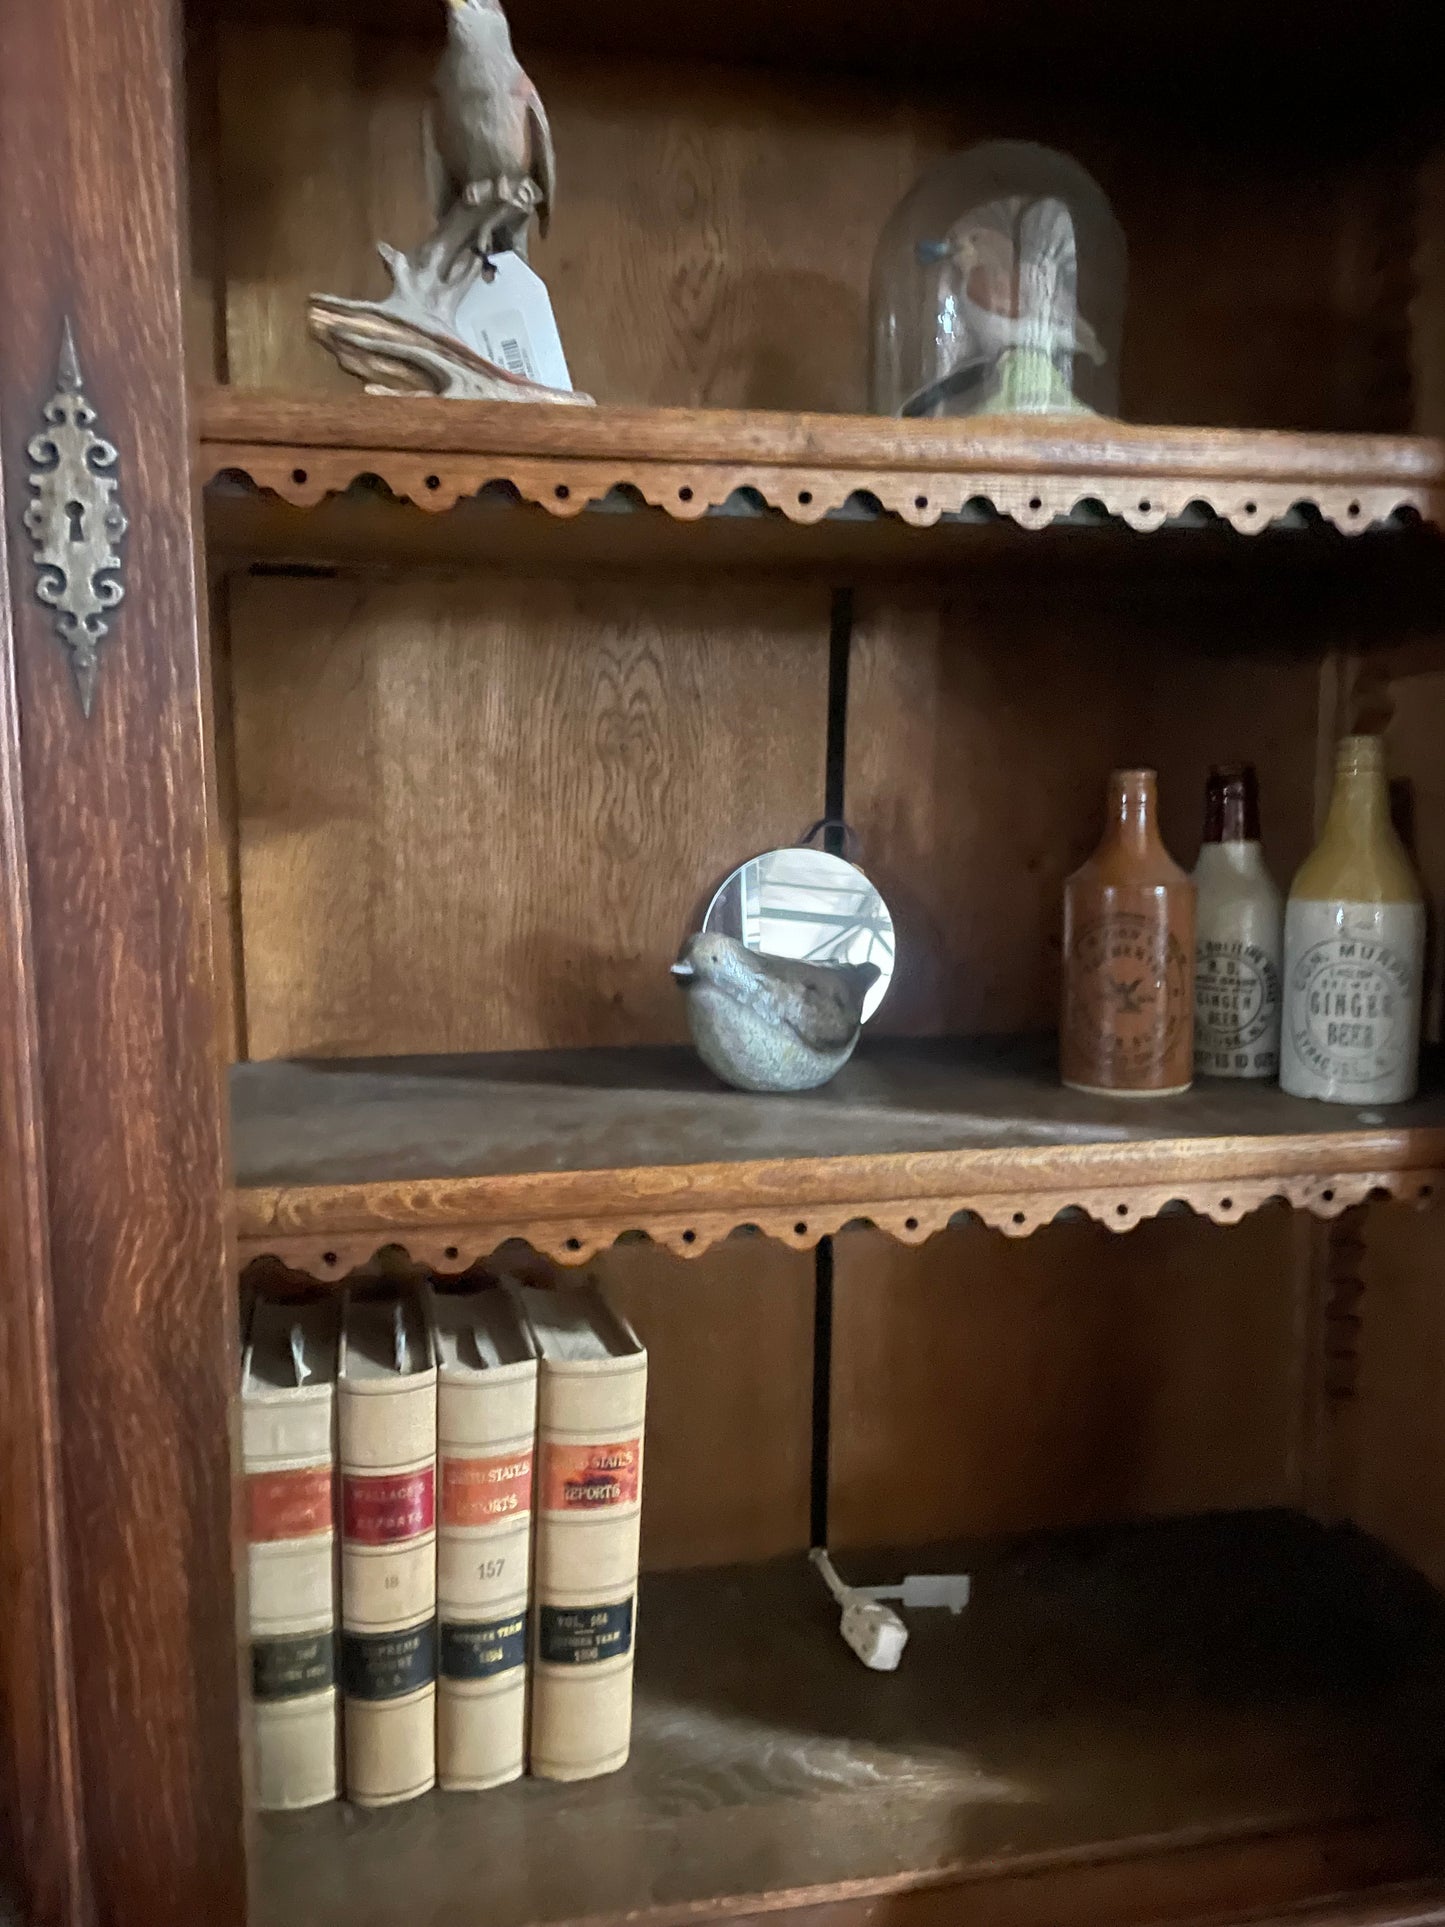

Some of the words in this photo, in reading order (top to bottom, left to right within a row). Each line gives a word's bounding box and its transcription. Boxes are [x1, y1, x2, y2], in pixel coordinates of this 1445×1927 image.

[1310, 990, 1393, 1019] GINGER
[1327, 1022, 1374, 1050] BEER
[591, 1450, 634, 1469] STATES
[487, 1460, 530, 1482] STATES
[564, 1483, 621, 1500] REPORTS
[478, 1559, 506, 1580] 157
